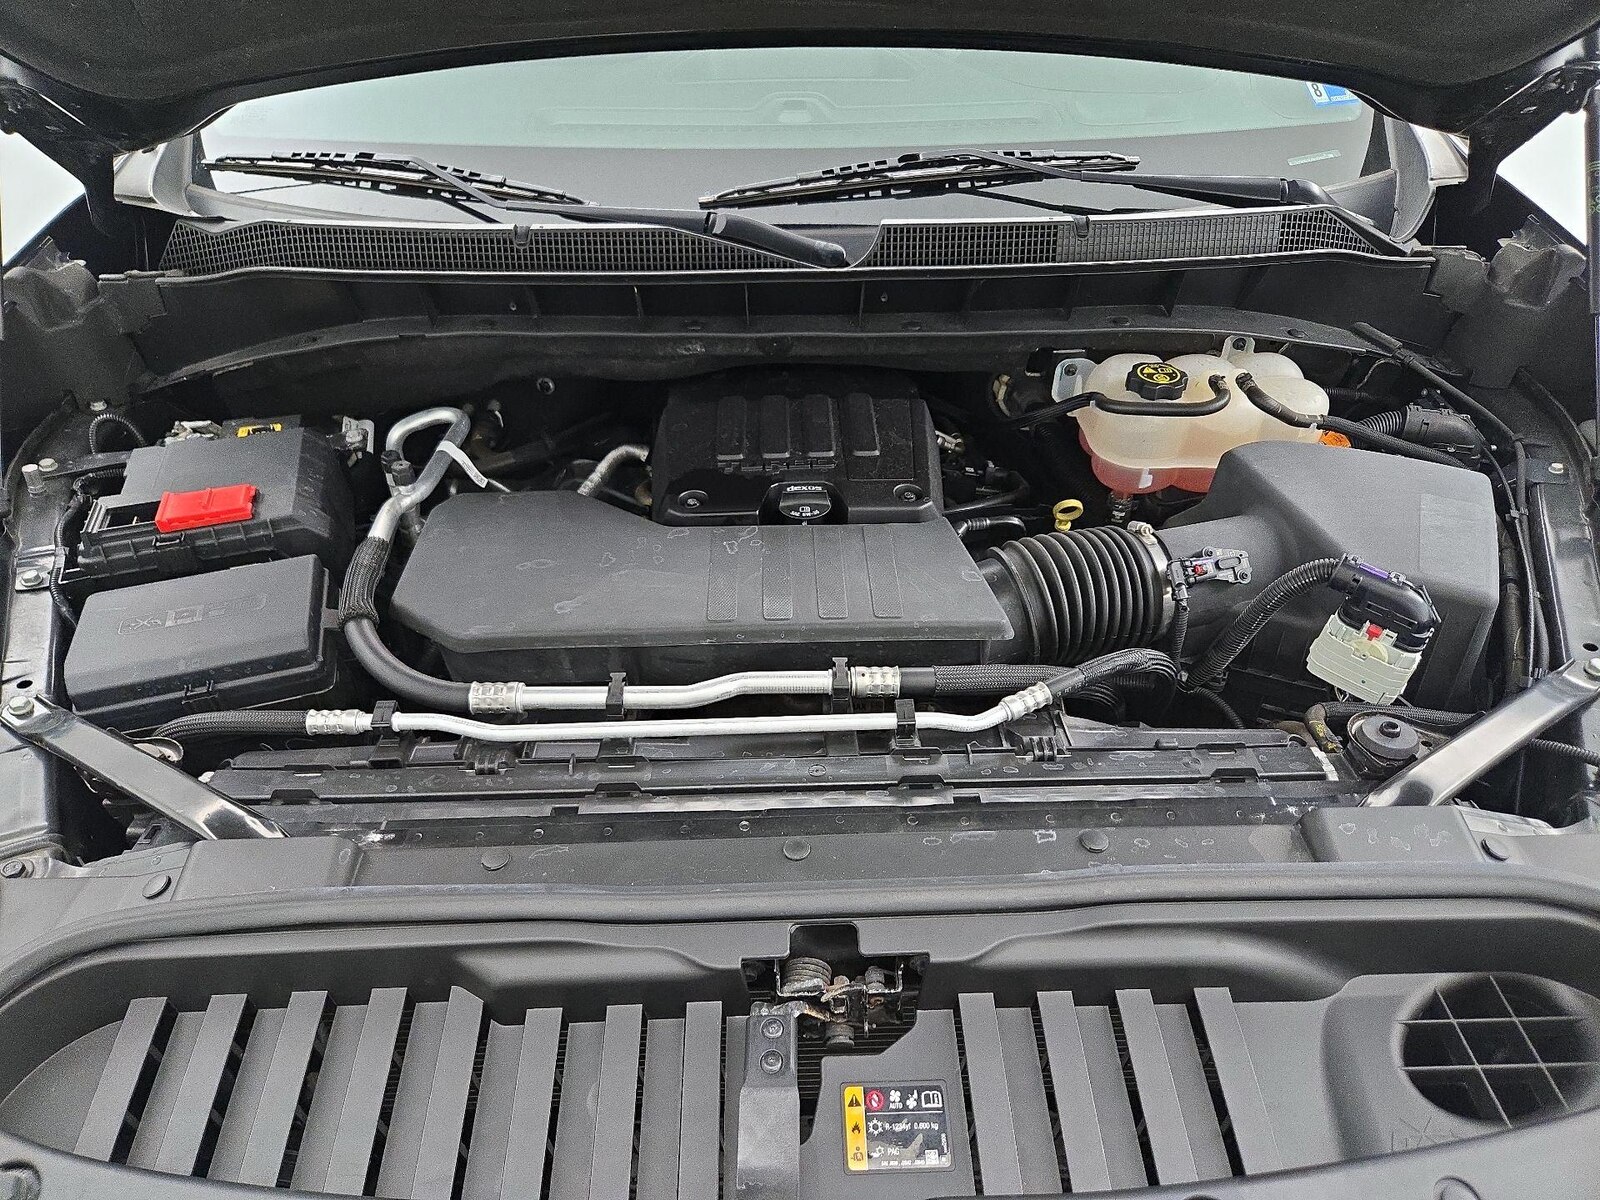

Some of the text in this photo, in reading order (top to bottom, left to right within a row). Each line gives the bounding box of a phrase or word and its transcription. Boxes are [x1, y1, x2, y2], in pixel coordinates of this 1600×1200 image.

[1311, 83, 1322, 97] 8
[889, 1102, 903, 1110] AUTO
[930, 1122, 939, 1131] kg
[887, 1148, 900, 1156] PAG
